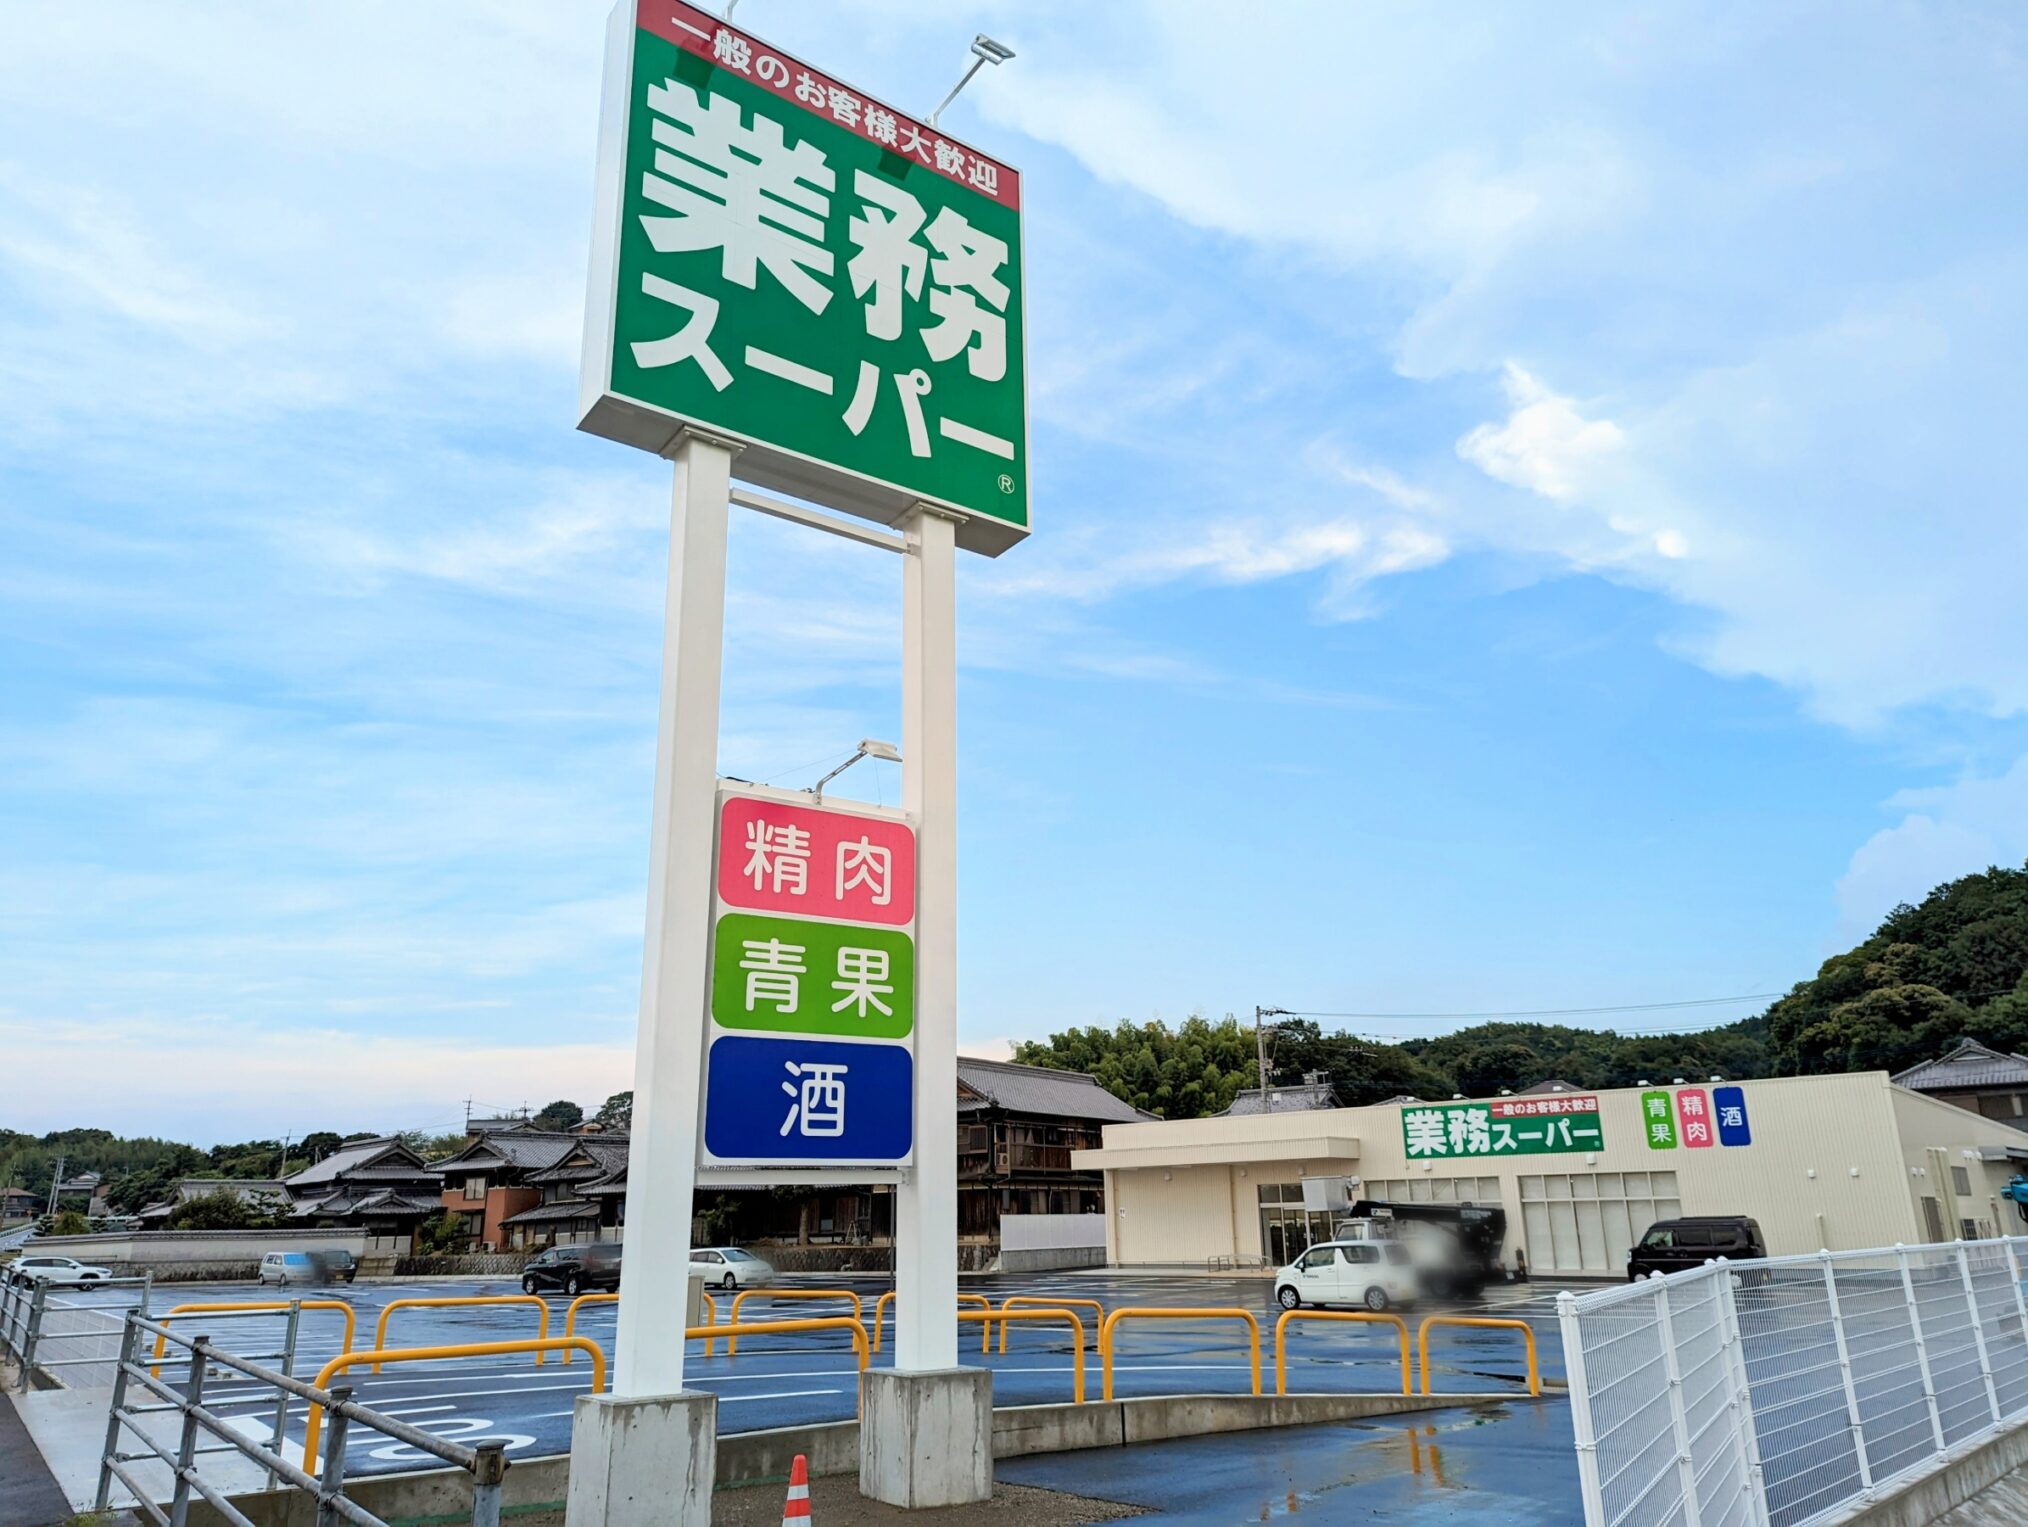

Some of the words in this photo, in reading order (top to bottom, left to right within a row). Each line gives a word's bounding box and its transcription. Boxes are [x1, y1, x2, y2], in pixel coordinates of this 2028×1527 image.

[672, 17, 997, 196] 一般のお客様大歓迎
[638, 78, 1011, 382] 業務
[630, 272, 1014, 460] スーパー
[743, 819, 891, 906] 精肉
[739, 937, 894, 1018] 青果
[779, 1060, 848, 1137] 酒
[1404, 1108, 1599, 1156] 業務スーパー
[1491, 1099, 1597, 1116] 一般のお客様大歓迎
[1647, 1098, 1673, 1142] 青果
[1681, 1096, 1708, 1141] 精肉
[1720, 1107, 1742, 1127] 酒
